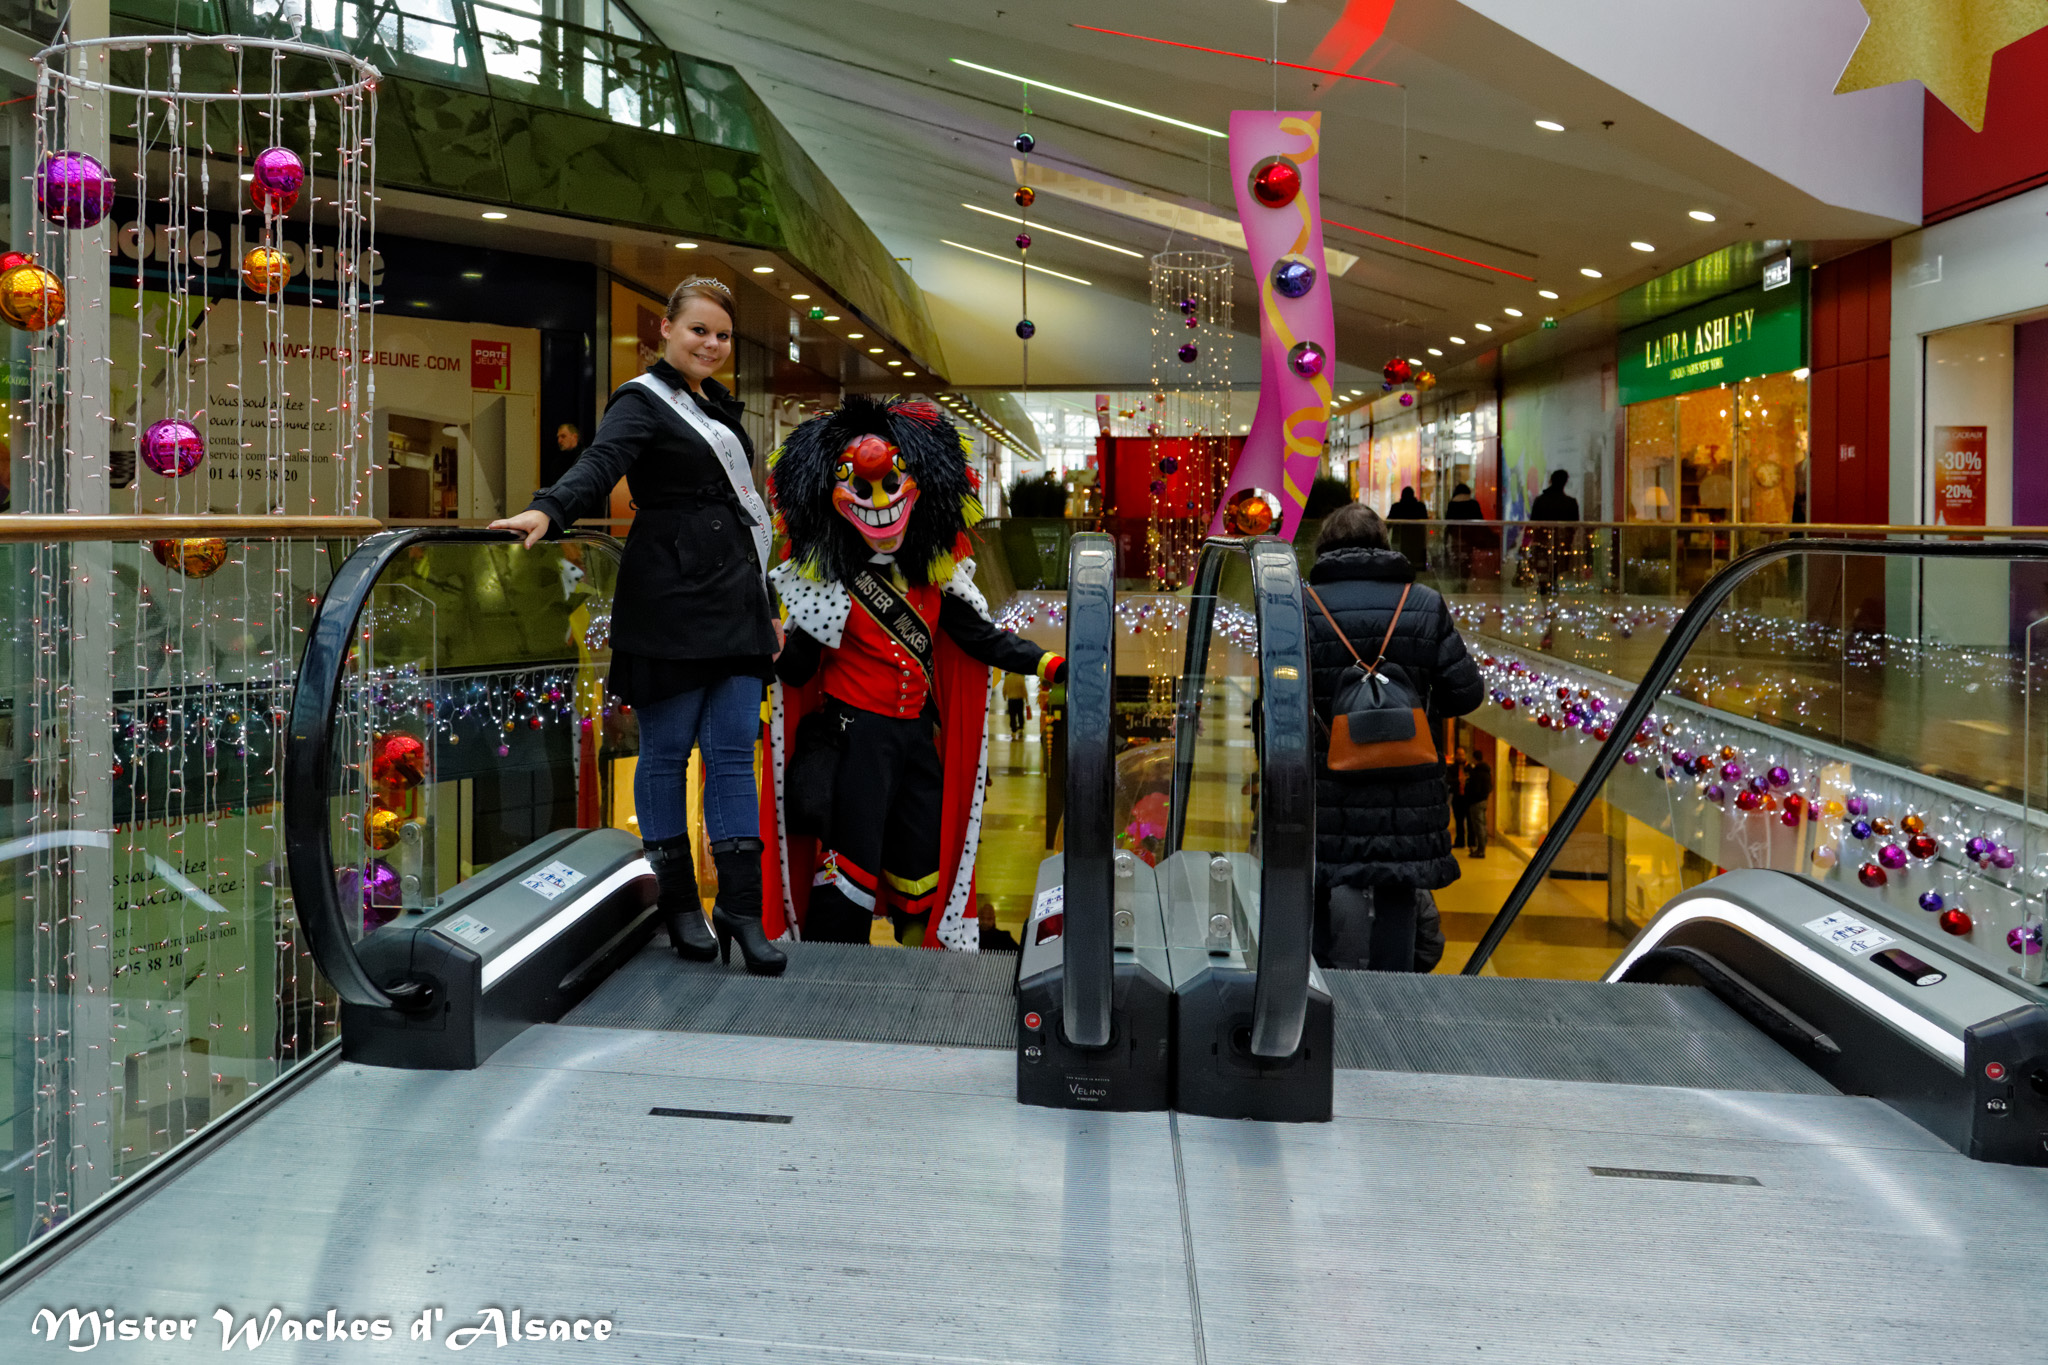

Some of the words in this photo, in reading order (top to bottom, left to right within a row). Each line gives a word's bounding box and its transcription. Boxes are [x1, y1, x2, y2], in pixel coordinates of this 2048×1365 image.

[1645, 330, 1689, 369] LAURA
[1693, 308, 1754, 356] ASHLEY
[475, 349, 507, 359] PORTE
[475, 357, 507, 367] JEUNE
[423, 355, 461, 372] .COM
[210, 394, 239, 406] Vous
[242, 396, 305, 411] souhatez
[209, 450, 243, 461] servic
[245, 450, 329, 463] commrcialistion
[1938, 451, 1982, 470] -30%
[209, 467, 223, 480] 01
[247, 468, 261, 480] 95
[285, 469, 298, 481] 20
[1941, 485, 1973, 499] -20%
[740, 485, 758, 511] MISS
[756, 514, 770, 551] ROND
[854, 570, 894, 614] MISTER
[893, 612, 928, 653] WACKES
